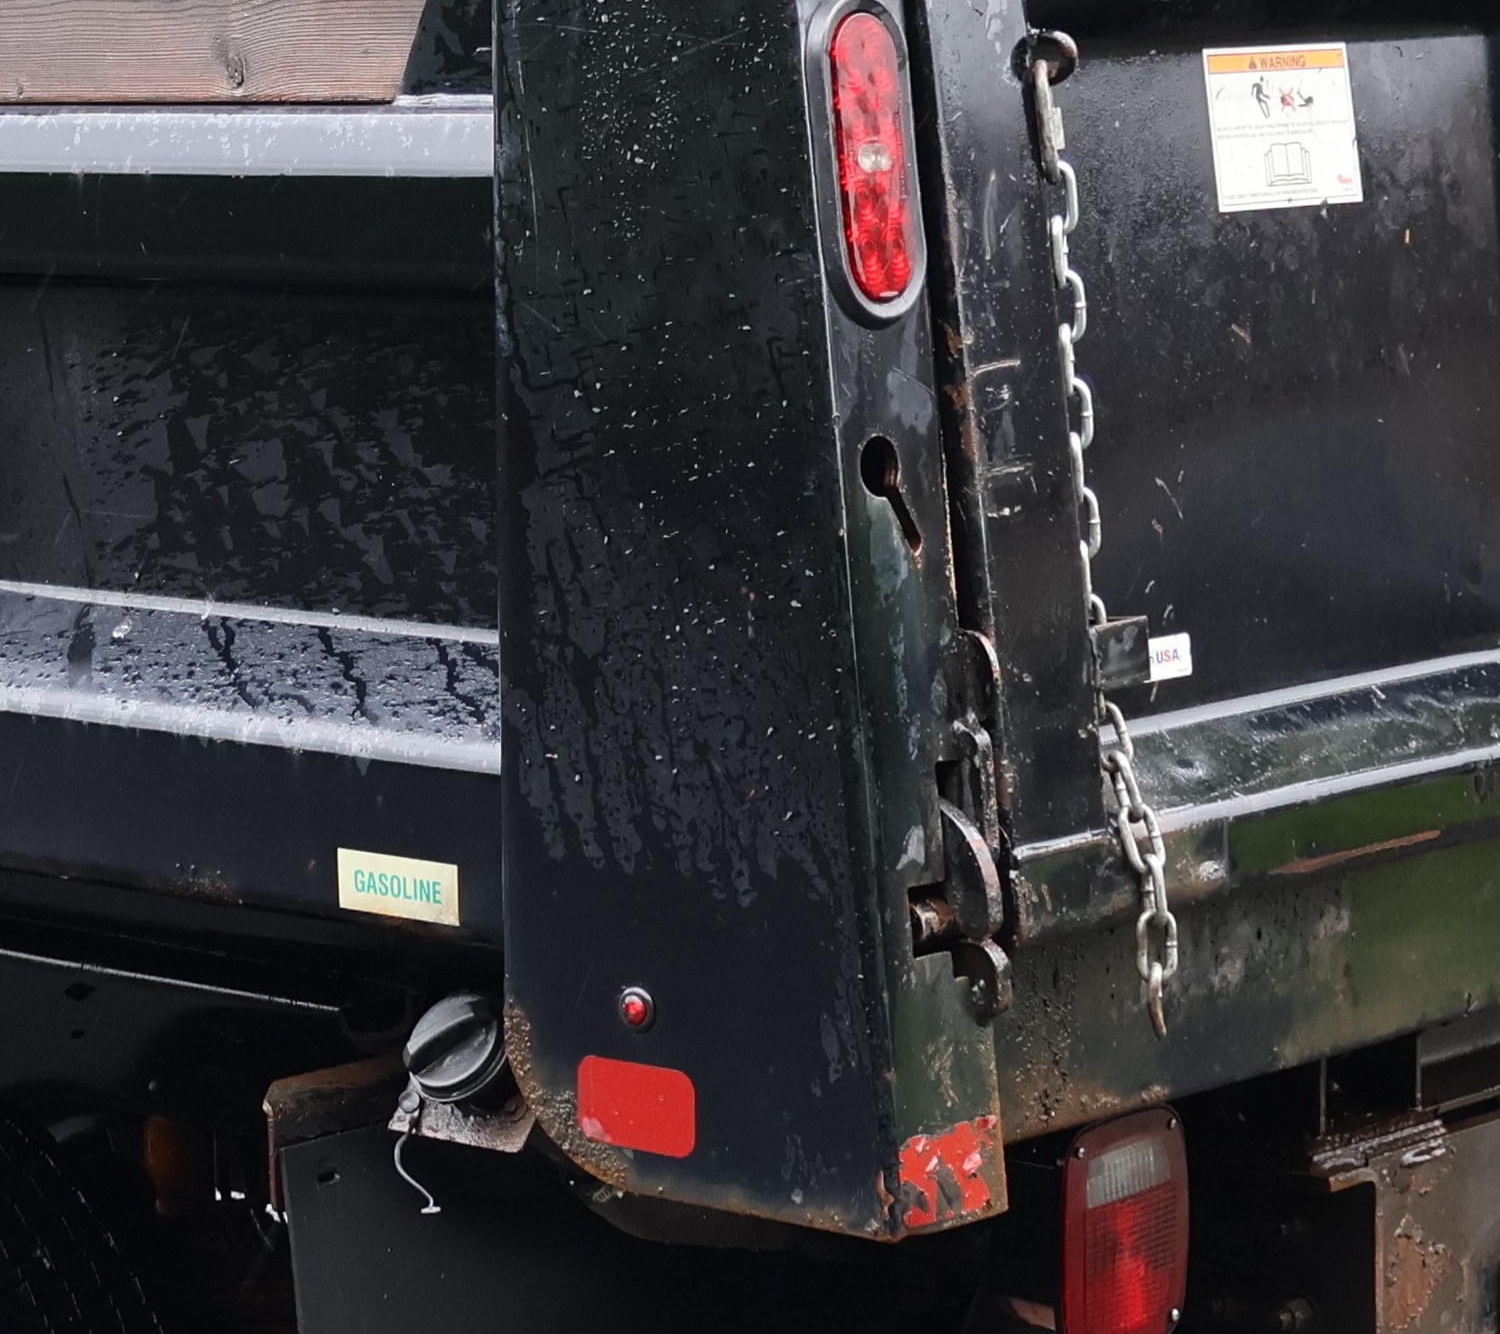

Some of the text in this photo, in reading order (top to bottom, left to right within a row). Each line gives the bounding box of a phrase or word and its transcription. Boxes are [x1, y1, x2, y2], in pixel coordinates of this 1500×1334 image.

[1259, 55, 1307, 69] WARNING
[1156, 649, 1180, 664] USA
[354, 869, 443, 905] GASOLINE
